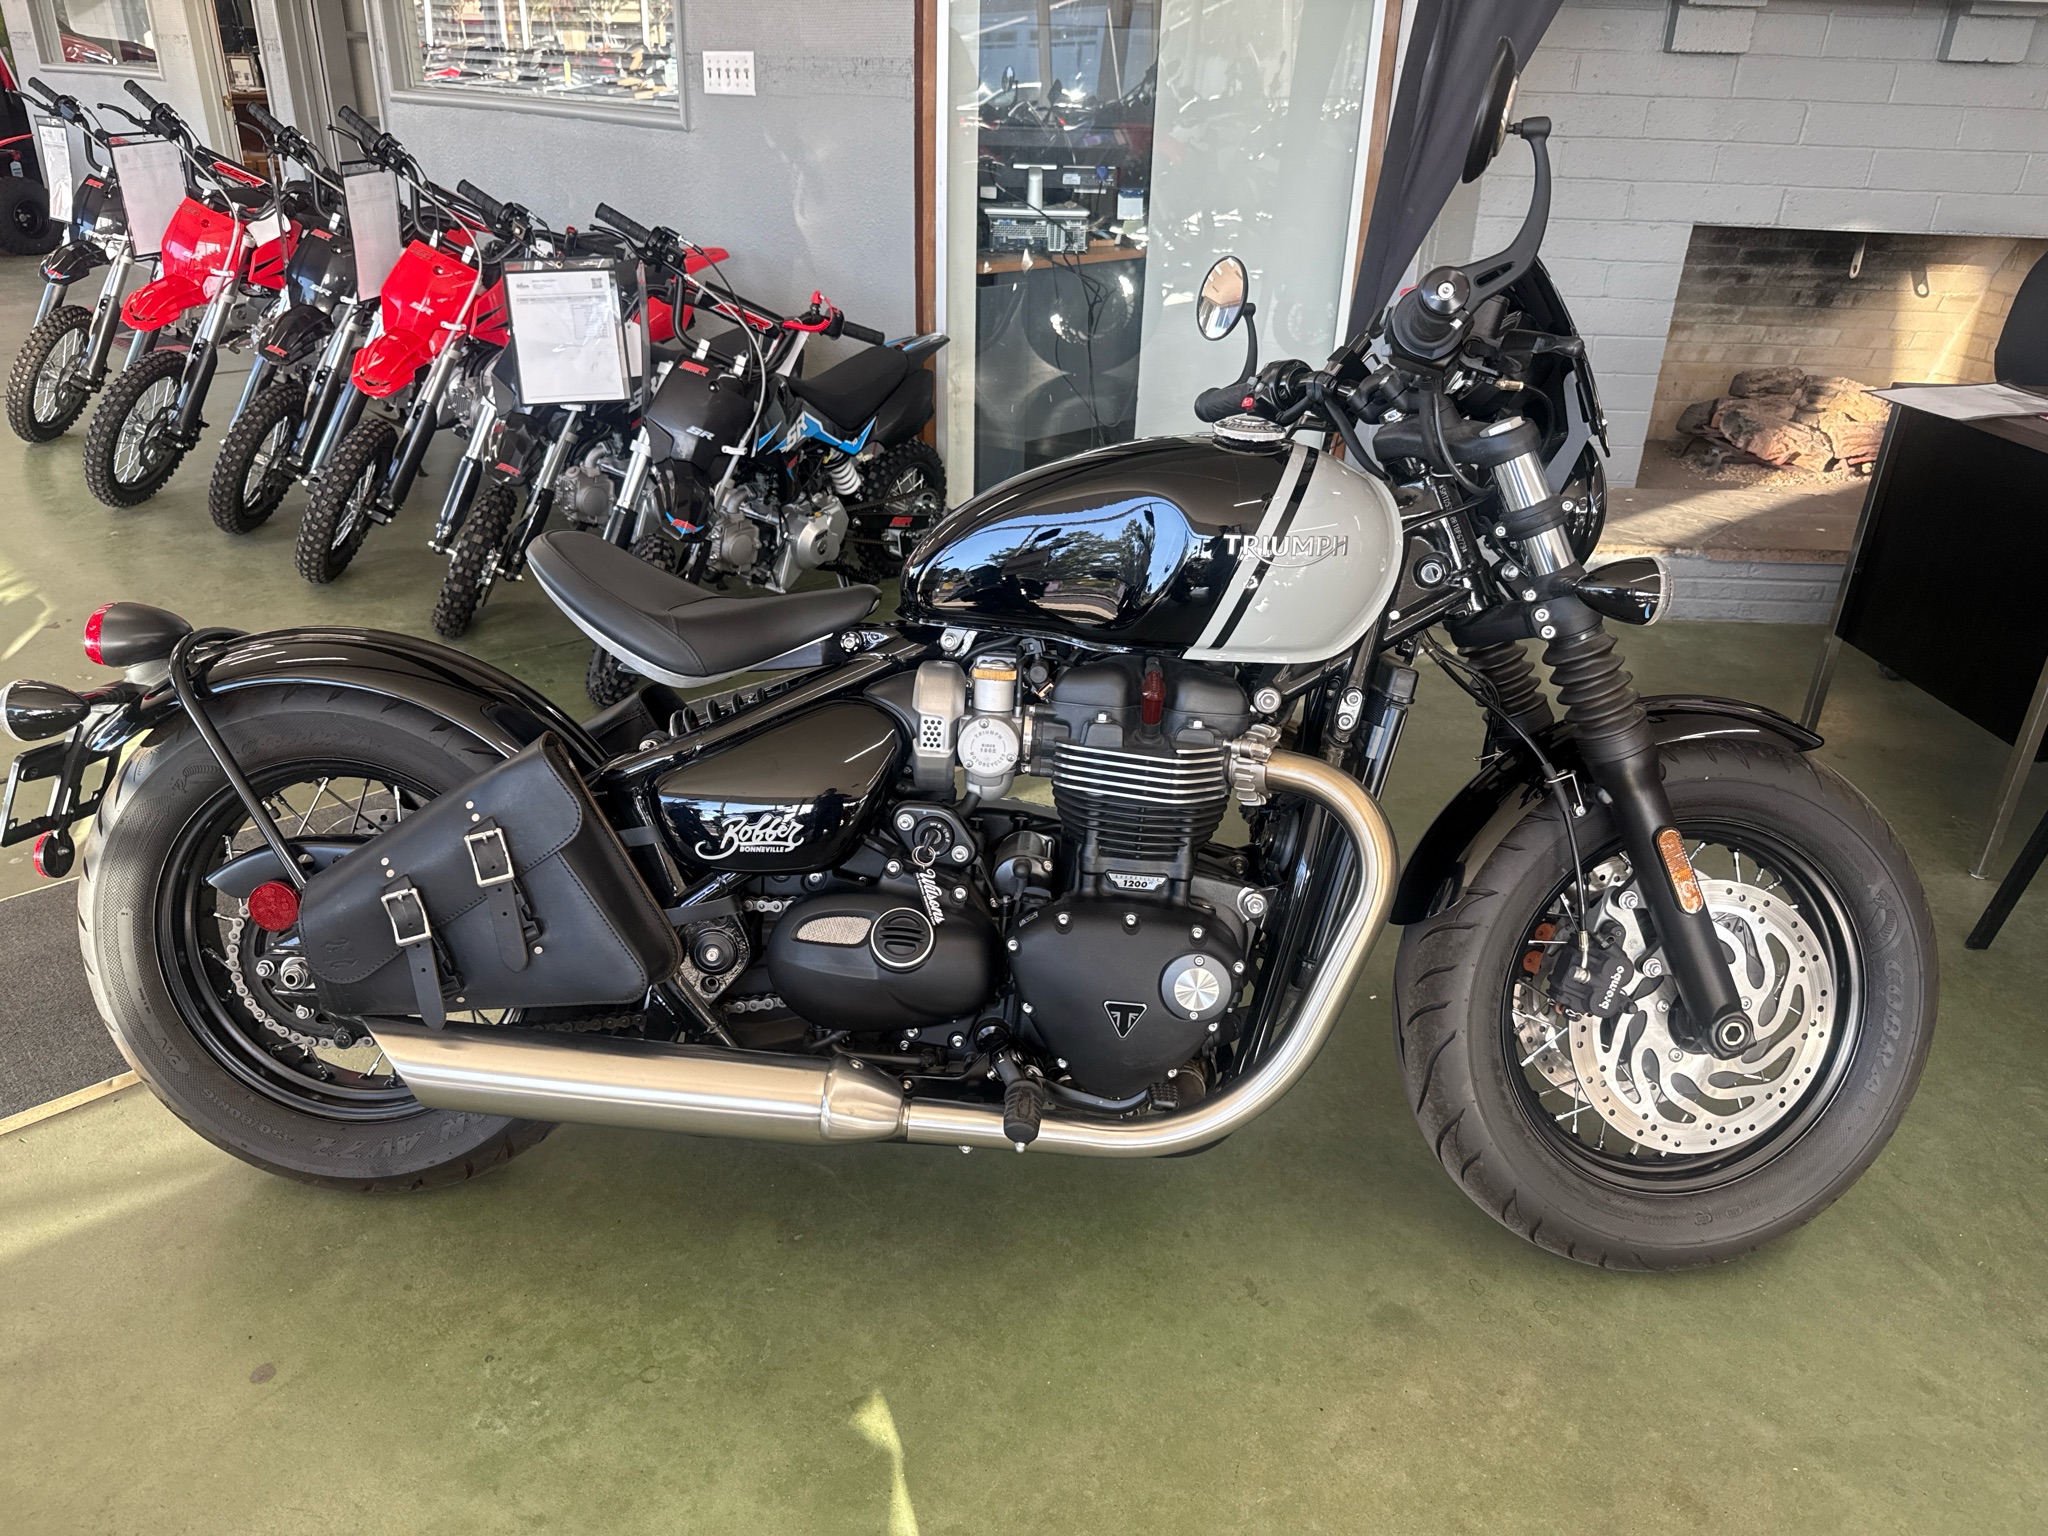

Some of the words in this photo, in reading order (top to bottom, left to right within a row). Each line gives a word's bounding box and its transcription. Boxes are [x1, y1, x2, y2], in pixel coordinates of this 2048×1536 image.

[686, 425, 715, 441] SR
[1223, 534, 1349, 562] TRIUMPH
[974, 729, 1003, 740] TRIUMPH
[970, 751, 1006, 768] MOTORCYCLES
[695, 812, 805, 860] Bobber
[739, 845, 785, 854] BONNEVILLE
[1122, 879, 1149, 889] 1200
[919, 868, 946, 924] Wilsons
[1598, 965, 1625, 1010] brembo
[1863, 959, 1904, 1097] COBRA
